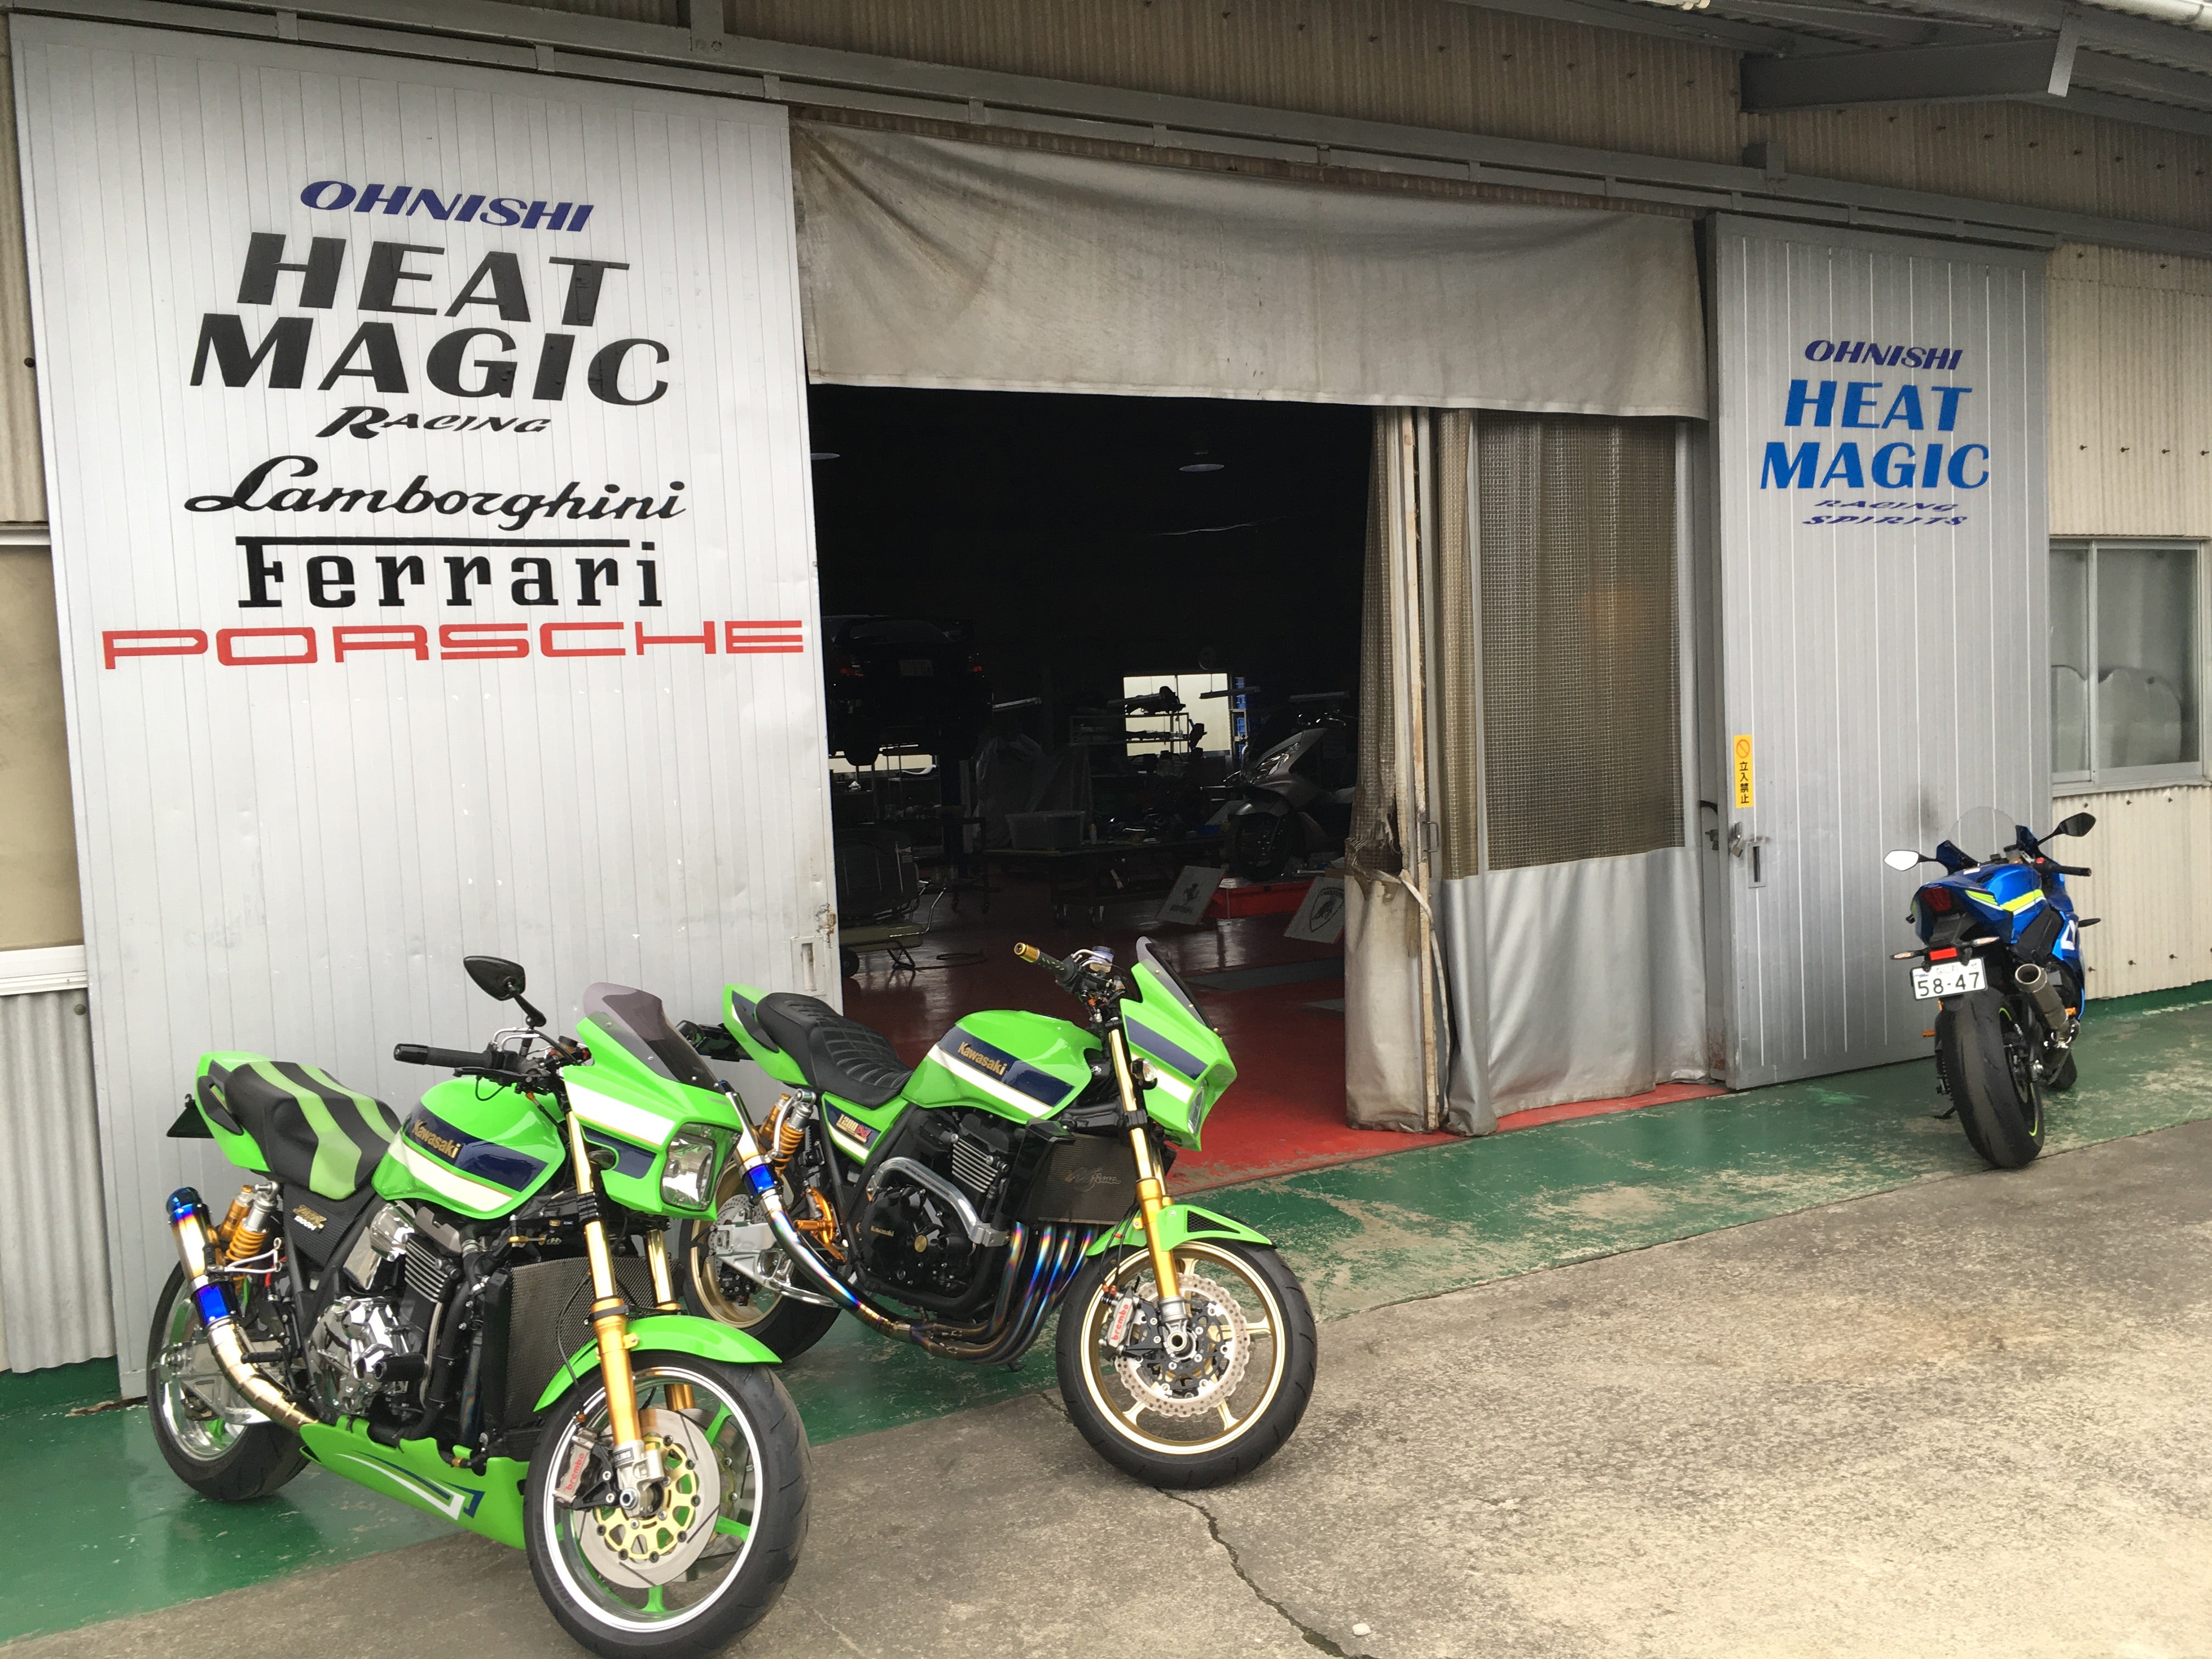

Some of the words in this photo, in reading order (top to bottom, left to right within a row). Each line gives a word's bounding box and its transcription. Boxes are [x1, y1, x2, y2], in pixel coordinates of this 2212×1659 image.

[300, 180, 594, 232] OHNISHI
[237, 232, 630, 326] HEAT
[190, 313, 670, 405] MAGIC
[1804, 340, 1963, 370] OHNISHI
[1784, 379, 1972, 431] HEAT
[1760, 441, 1989, 489] MAGIC
[184, 455, 686, 532] Lamborghini
[1814, 500, 1959, 511] RACING
[1802, 515, 1968, 525] SPIRITS
[236, 536, 663, 608] Ferrari
[101, 620, 804, 670] PORSCHE
[1739, 761, 1750, 804] 立入禁止
[1917, 972, 1979, 997] 58-47
[957, 1041, 1008, 1076] Kawasaki
[412, 1119, 461, 1159] Kawasaki
[1111, 1304, 1129, 1341] brembo
[565, 1453, 585, 1491] brembo
